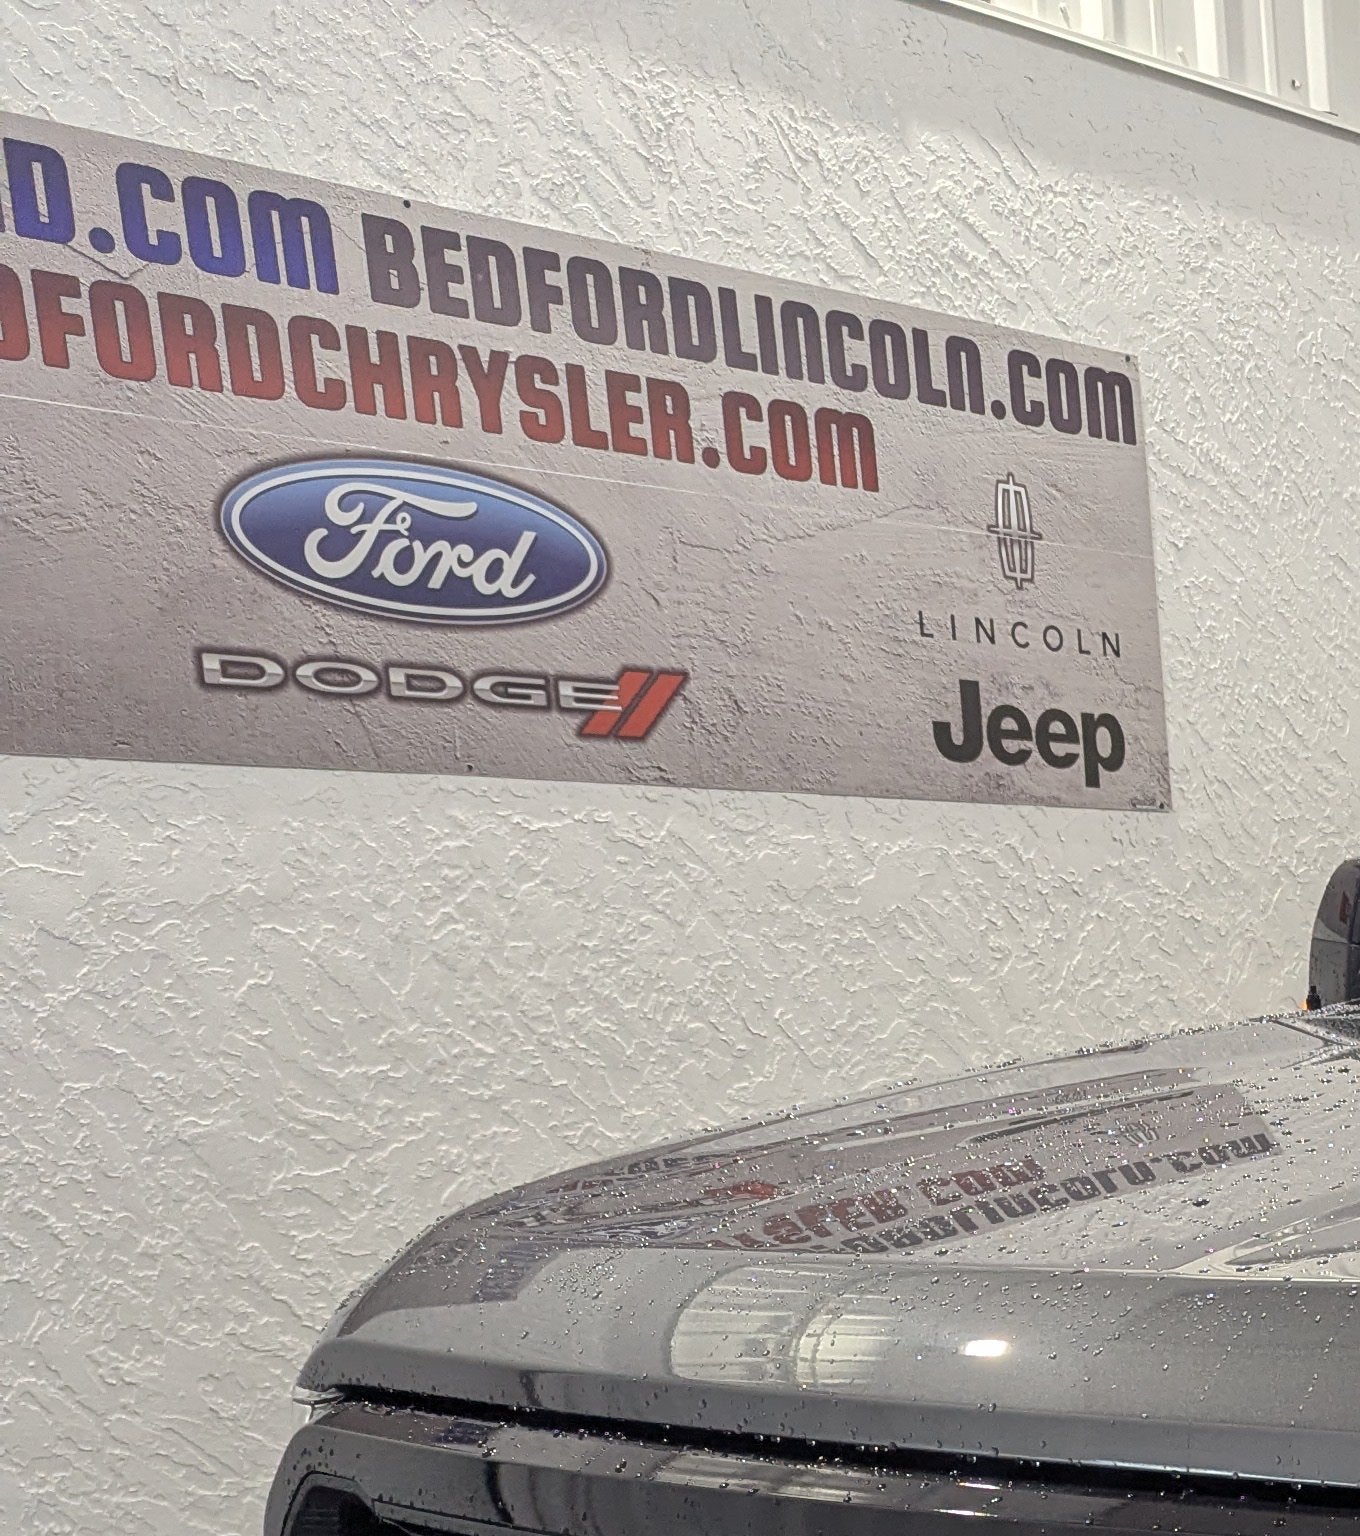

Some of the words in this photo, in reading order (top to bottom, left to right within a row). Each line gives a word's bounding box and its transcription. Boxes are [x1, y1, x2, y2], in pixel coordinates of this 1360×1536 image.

[0, 136, 340, 295] D.COM
[361, 212, 1138, 446] BEDFORDLINCOLN.COM
[303, 482, 538, 600] Ford
[200, 649, 625, 713] DODGE
[917, 609, 1122, 658] LINCOLN
[932, 679, 1126, 789] Jeep
